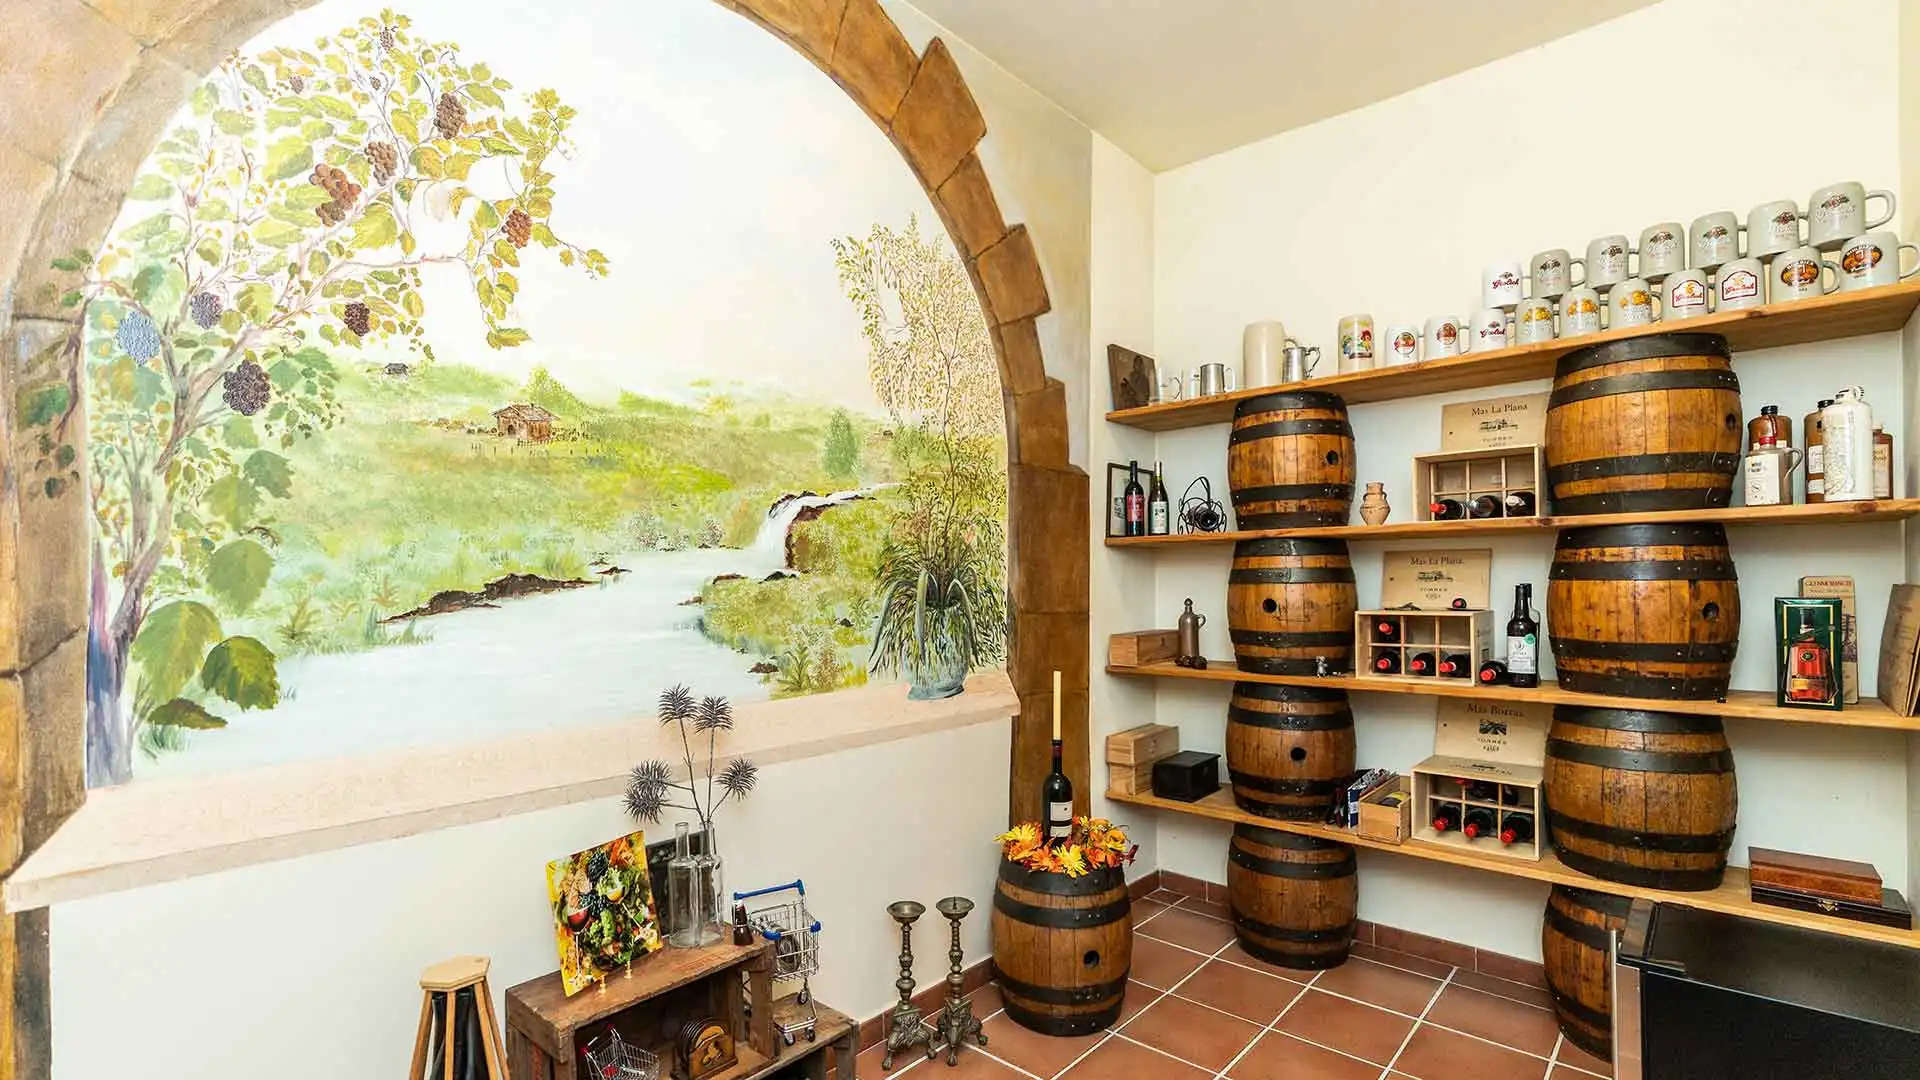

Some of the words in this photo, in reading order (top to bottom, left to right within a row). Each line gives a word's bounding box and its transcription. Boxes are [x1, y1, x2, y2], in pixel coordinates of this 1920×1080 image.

[1471, 407, 1489, 416] Mas
[1491, 405, 1502, 413] La
[1504, 402, 1529, 412] Plana
[1410, 557, 1427, 566] Mas
[1429, 557, 1439, 565] La
